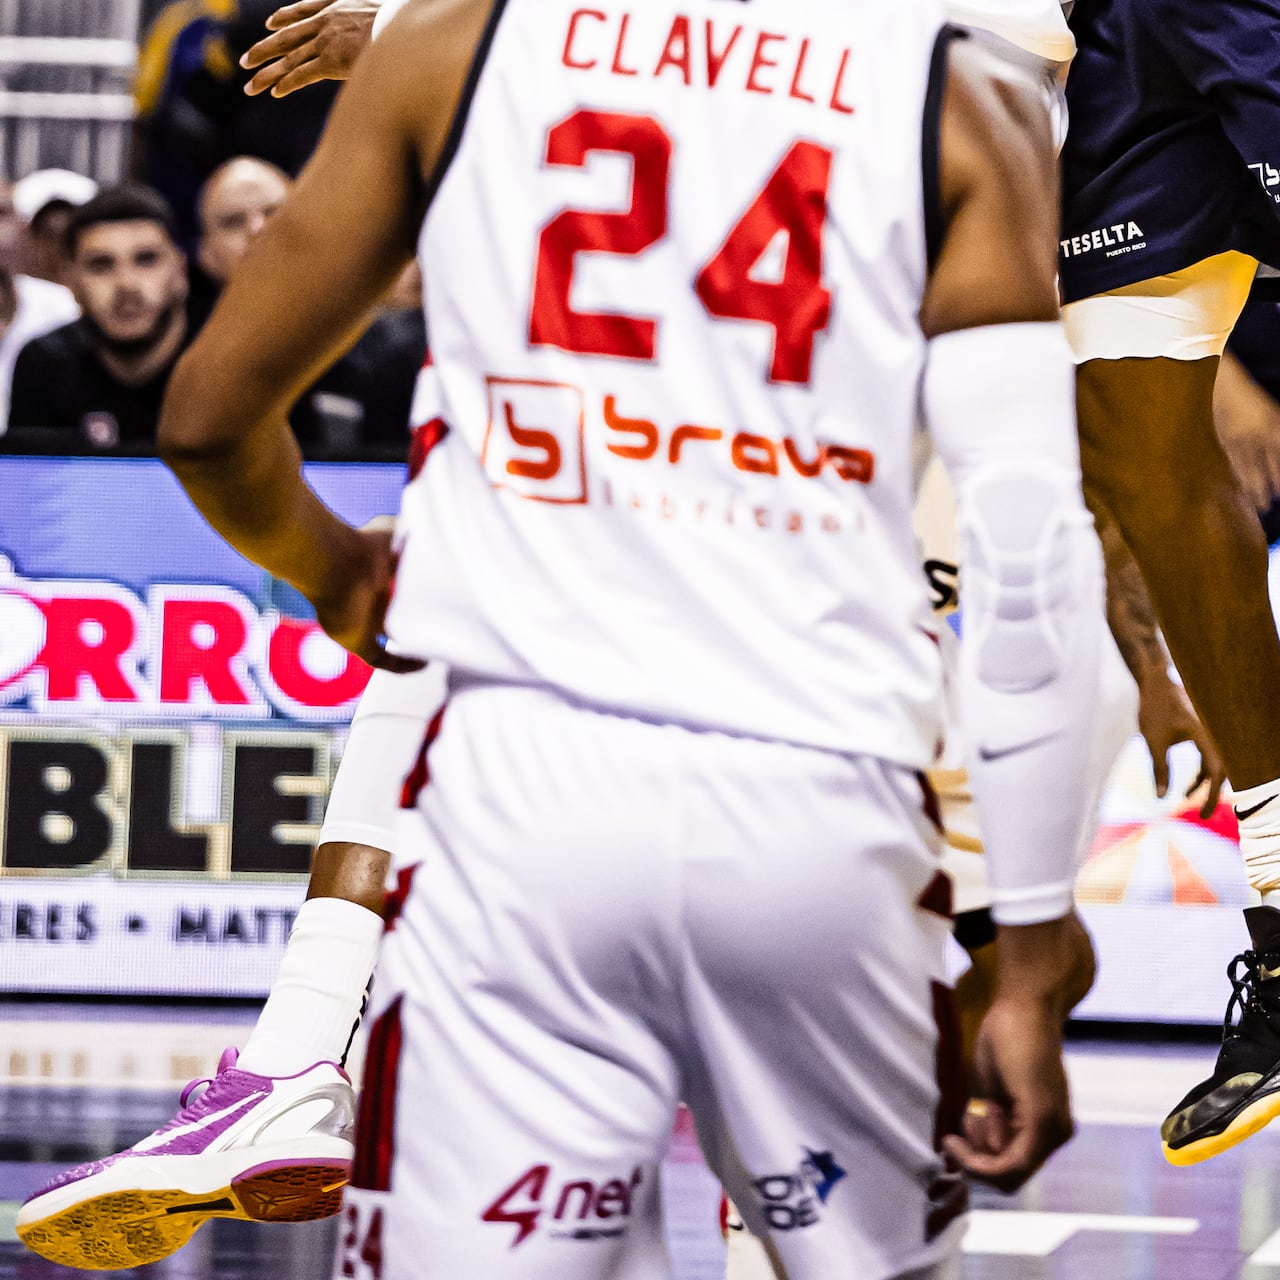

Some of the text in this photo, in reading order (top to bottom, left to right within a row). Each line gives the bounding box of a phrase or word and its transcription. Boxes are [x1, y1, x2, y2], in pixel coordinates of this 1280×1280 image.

[561, 8, 856, 115] CLAVELL
[526, 107, 834, 387] 24
[1059, 220, 1144, 258] TESELTA
[1105, 241, 1147, 258] PUERTO RICO
[603, 394, 875, 484] brava
[0, 902, 96, 942] RES
